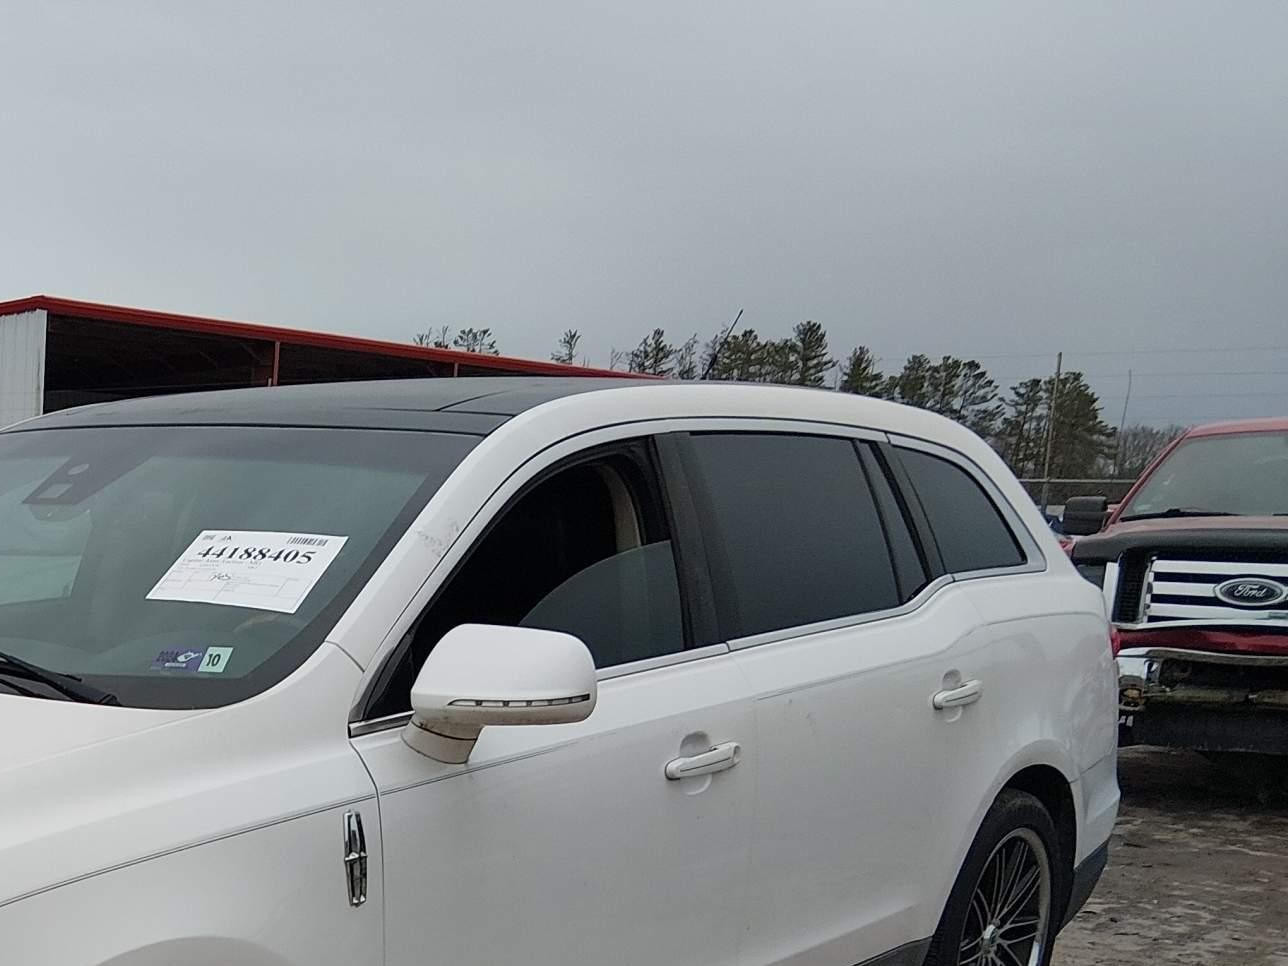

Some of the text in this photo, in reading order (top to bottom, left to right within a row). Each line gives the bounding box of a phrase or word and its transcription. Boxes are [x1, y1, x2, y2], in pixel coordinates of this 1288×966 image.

[197, 545, 317, 564] 44188405
[1233, 584, 1268, 598] Ford
[206, 653, 222, 667] 10
